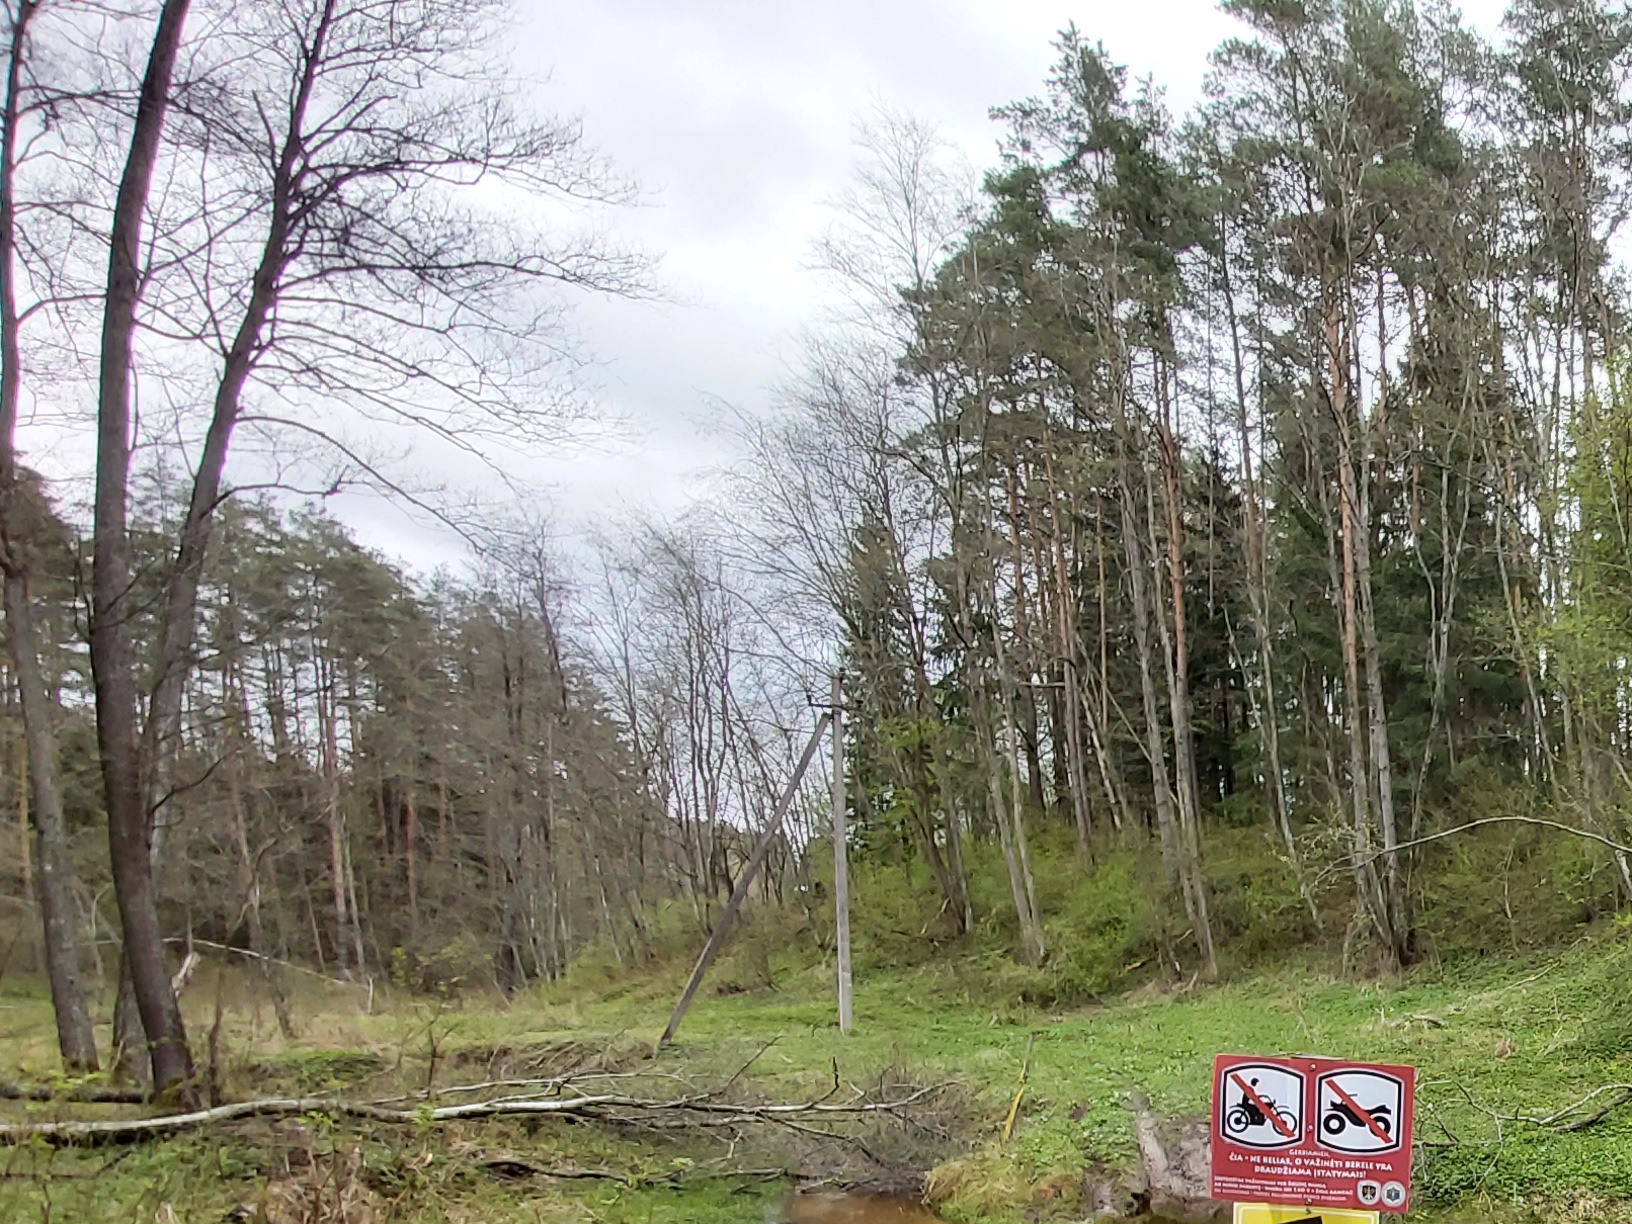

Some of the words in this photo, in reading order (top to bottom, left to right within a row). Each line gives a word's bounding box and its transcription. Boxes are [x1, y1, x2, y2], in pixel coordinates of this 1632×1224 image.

[1229, 1152, 1243, 1162] ČIA
[1250, 1155, 1261, 1163] NE
[1263, 1156, 1292, 1166] KELIAS,
[1304, 1157, 1343, 1168] VAŽINĖTI
[1345, 1160, 1374, 1169] BEKELE
[1375, 1162, 1392, 1171] YRA
[1254, 1165, 1312, 1176] DRAUDŽIAMA
[1313, 1168, 1367, 1178] ĮSTATYMAIS!
